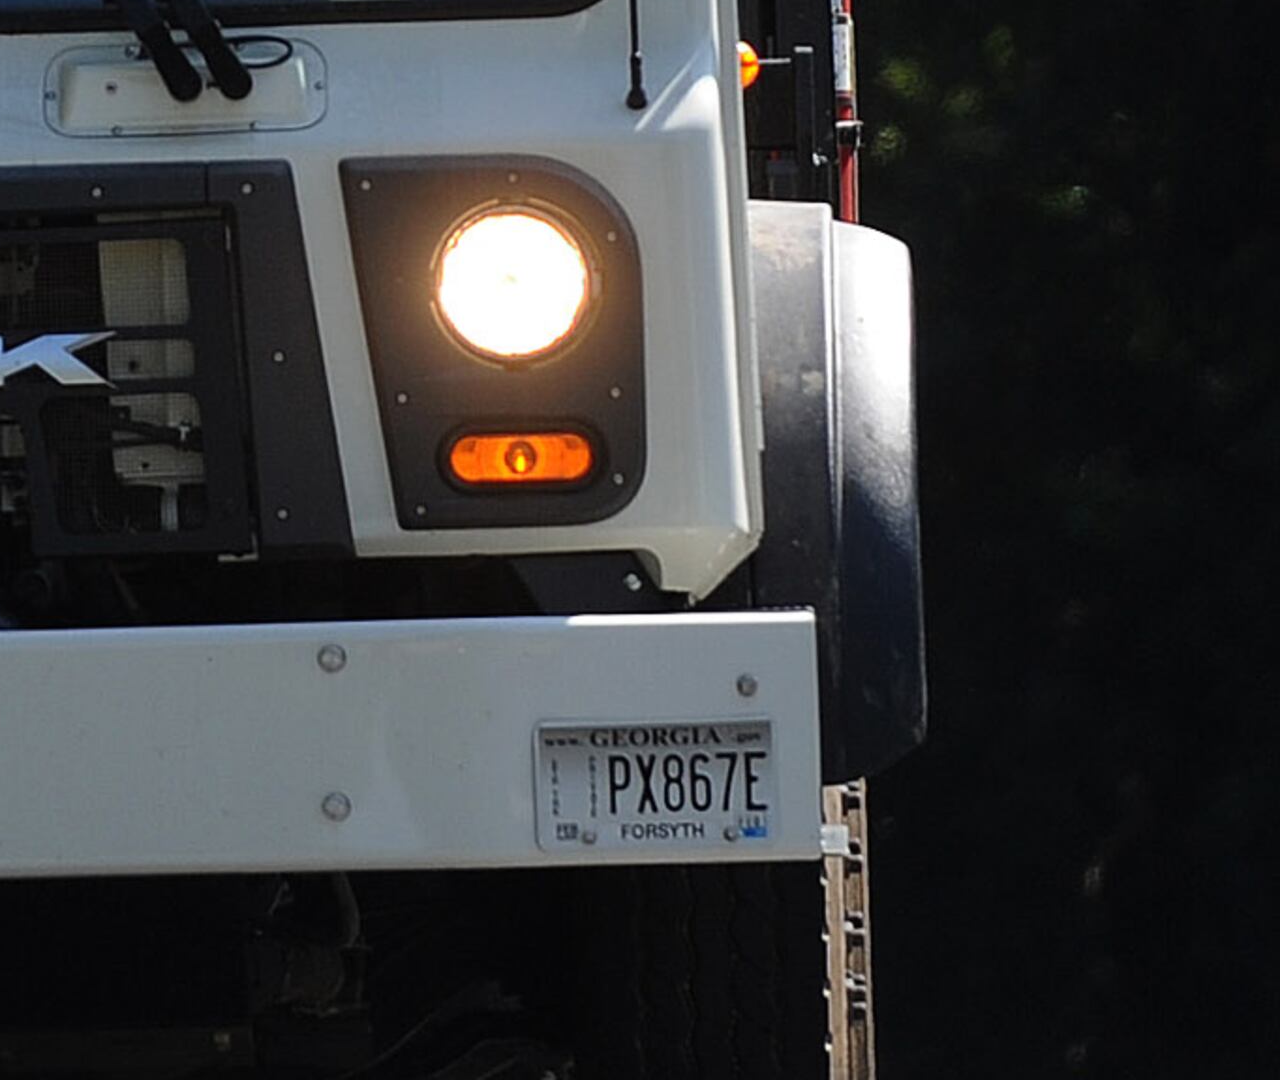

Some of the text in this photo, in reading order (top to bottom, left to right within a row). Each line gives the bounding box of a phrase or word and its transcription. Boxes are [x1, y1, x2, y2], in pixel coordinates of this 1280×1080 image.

[589, 727, 721, 748] GEORGIA
[607, 751, 768, 815] PX867E
[621, 822, 705, 840] FORSYTH
